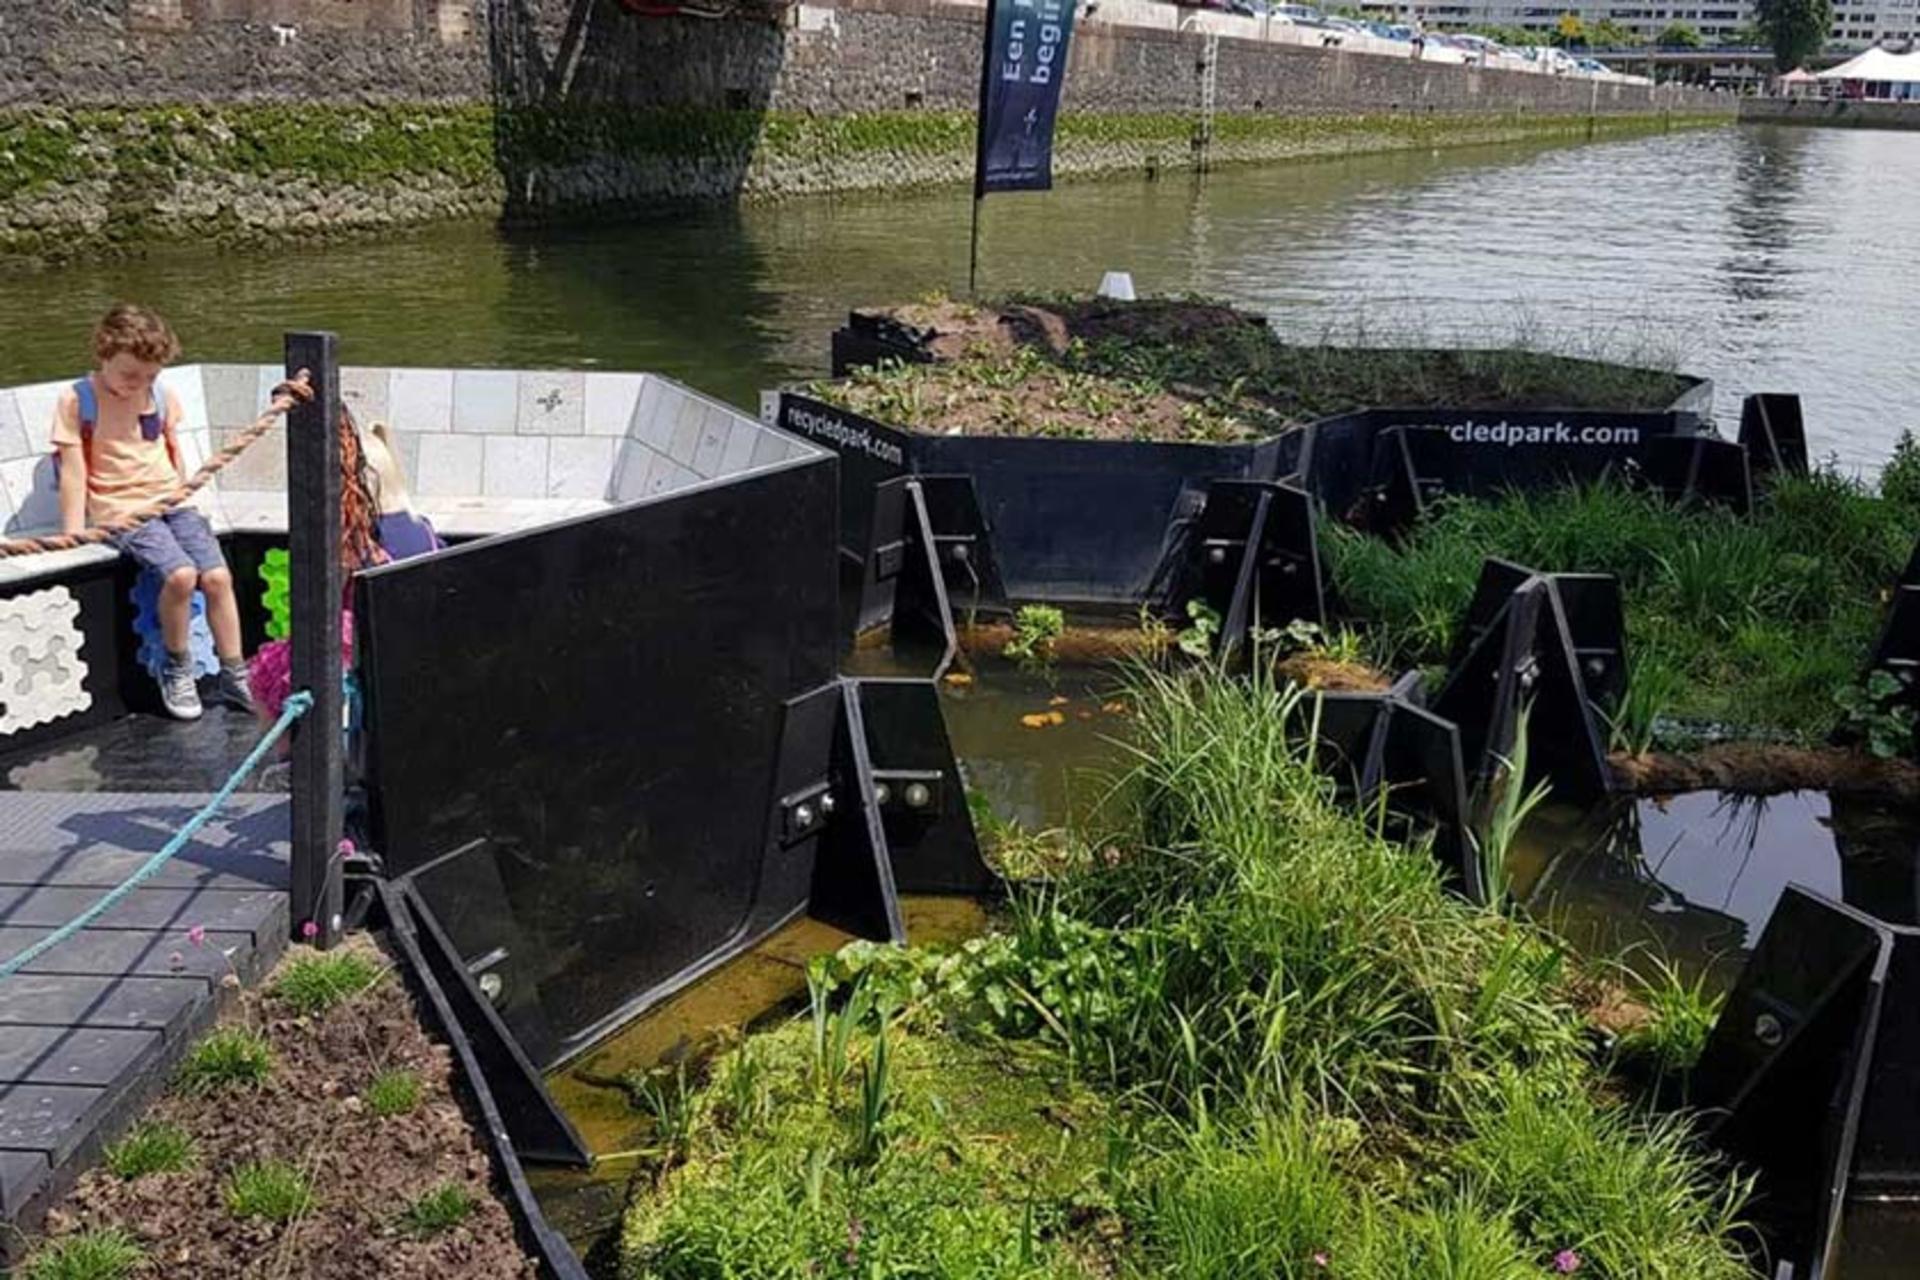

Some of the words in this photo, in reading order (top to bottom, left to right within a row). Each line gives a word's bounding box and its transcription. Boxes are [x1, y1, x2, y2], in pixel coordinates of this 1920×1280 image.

[1002, 20, 1025, 81] Een
[788, 407, 902, 464] recycledpark.com
[1446, 421, 1639, 446] cledpark.com
